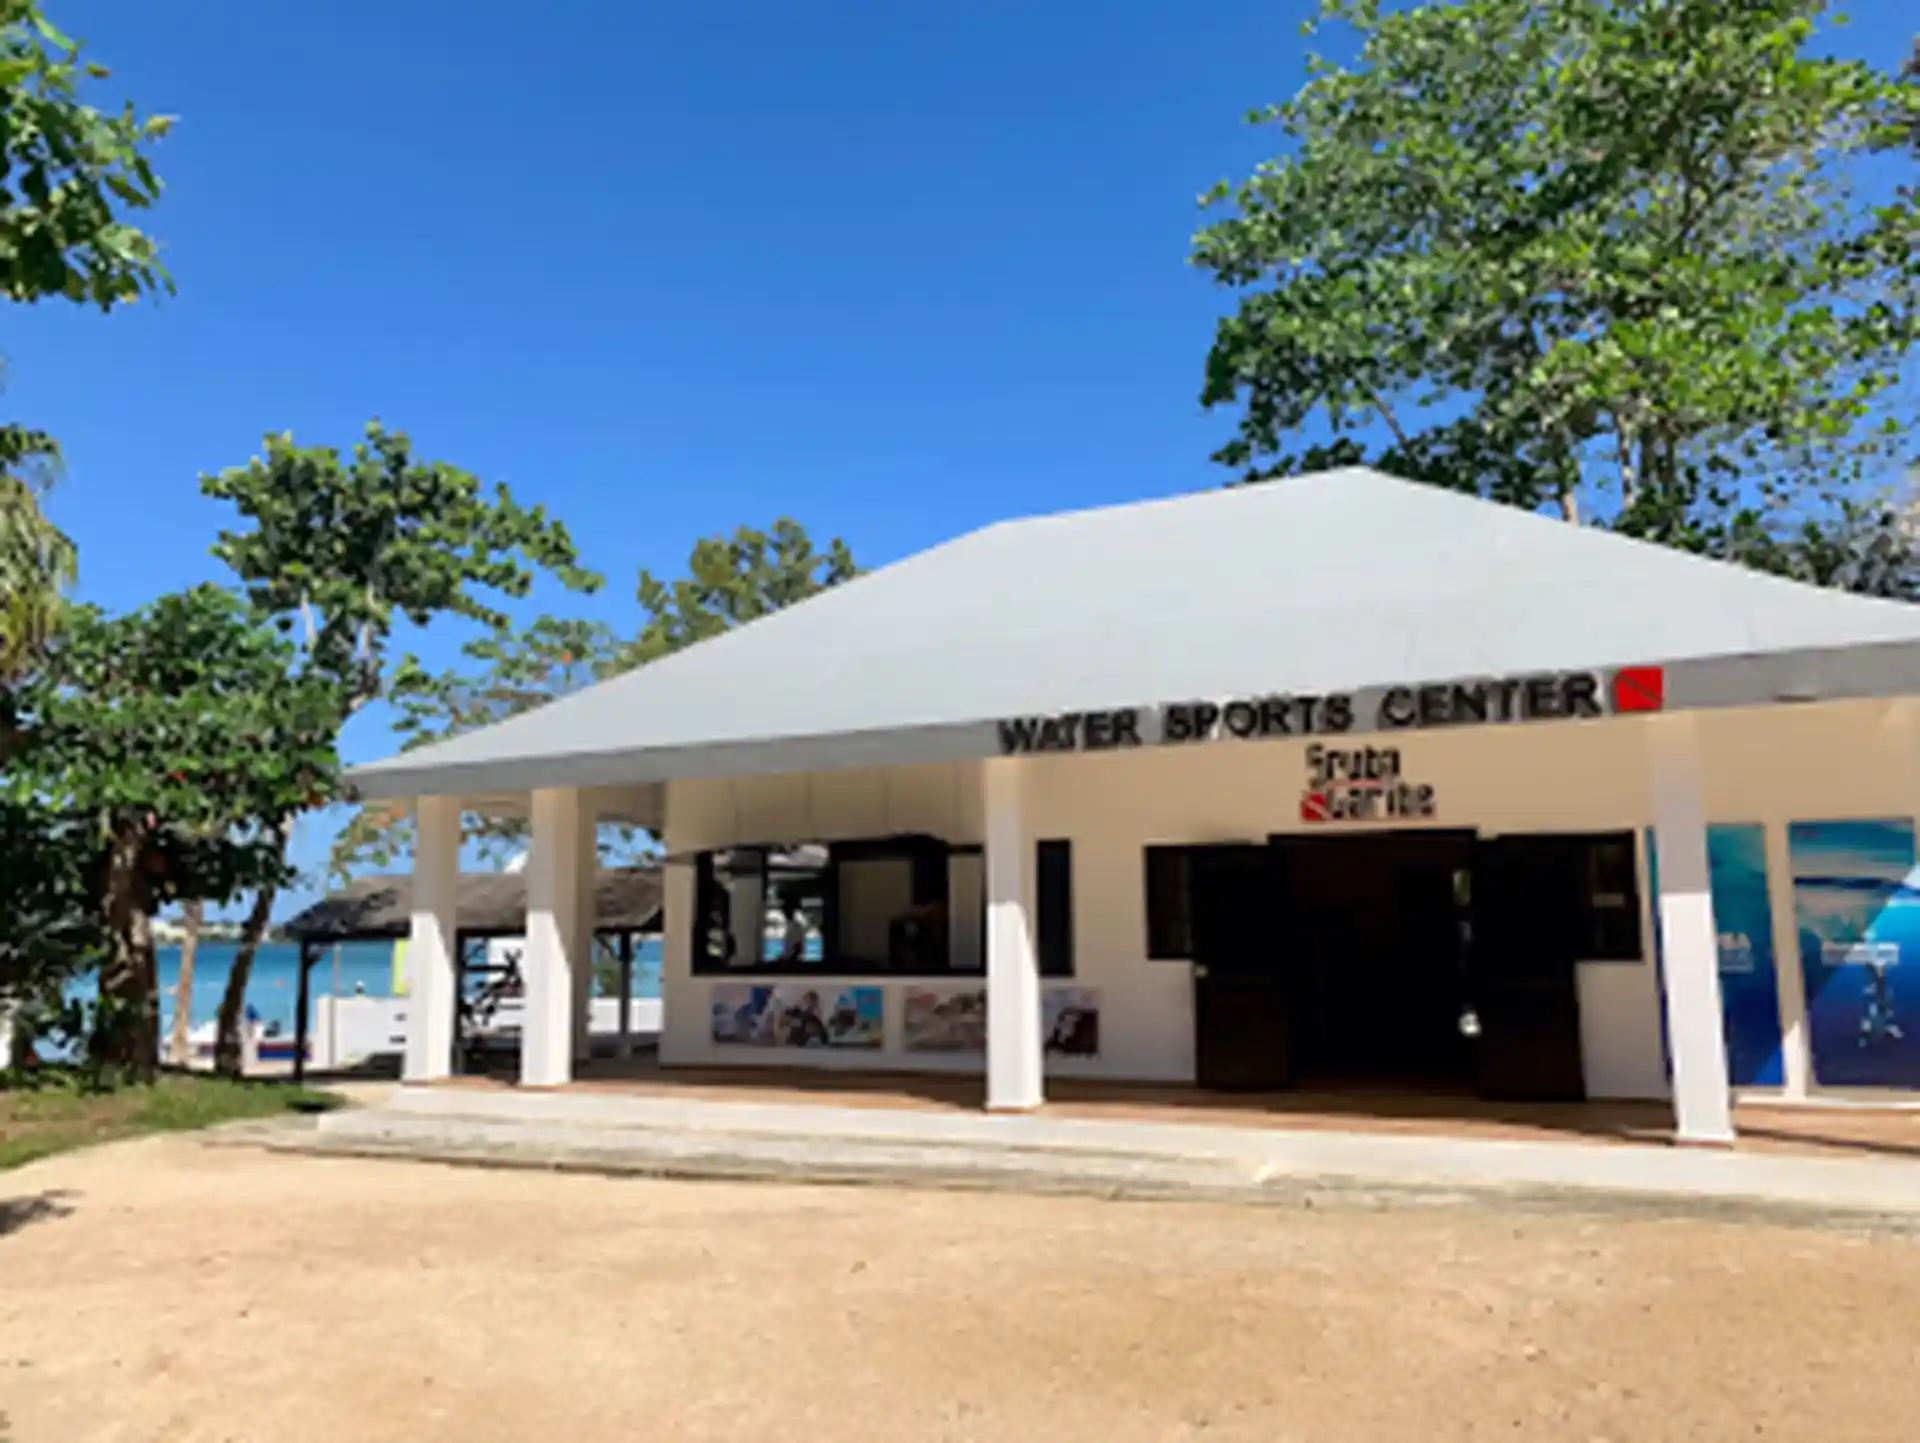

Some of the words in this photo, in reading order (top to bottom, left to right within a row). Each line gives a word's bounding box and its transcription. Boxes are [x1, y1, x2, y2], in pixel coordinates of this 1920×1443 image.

[998, 710, 1141, 754] WATER
[1164, 694, 1353, 739] SPORTS
[1380, 671, 1602, 726] CENTER
